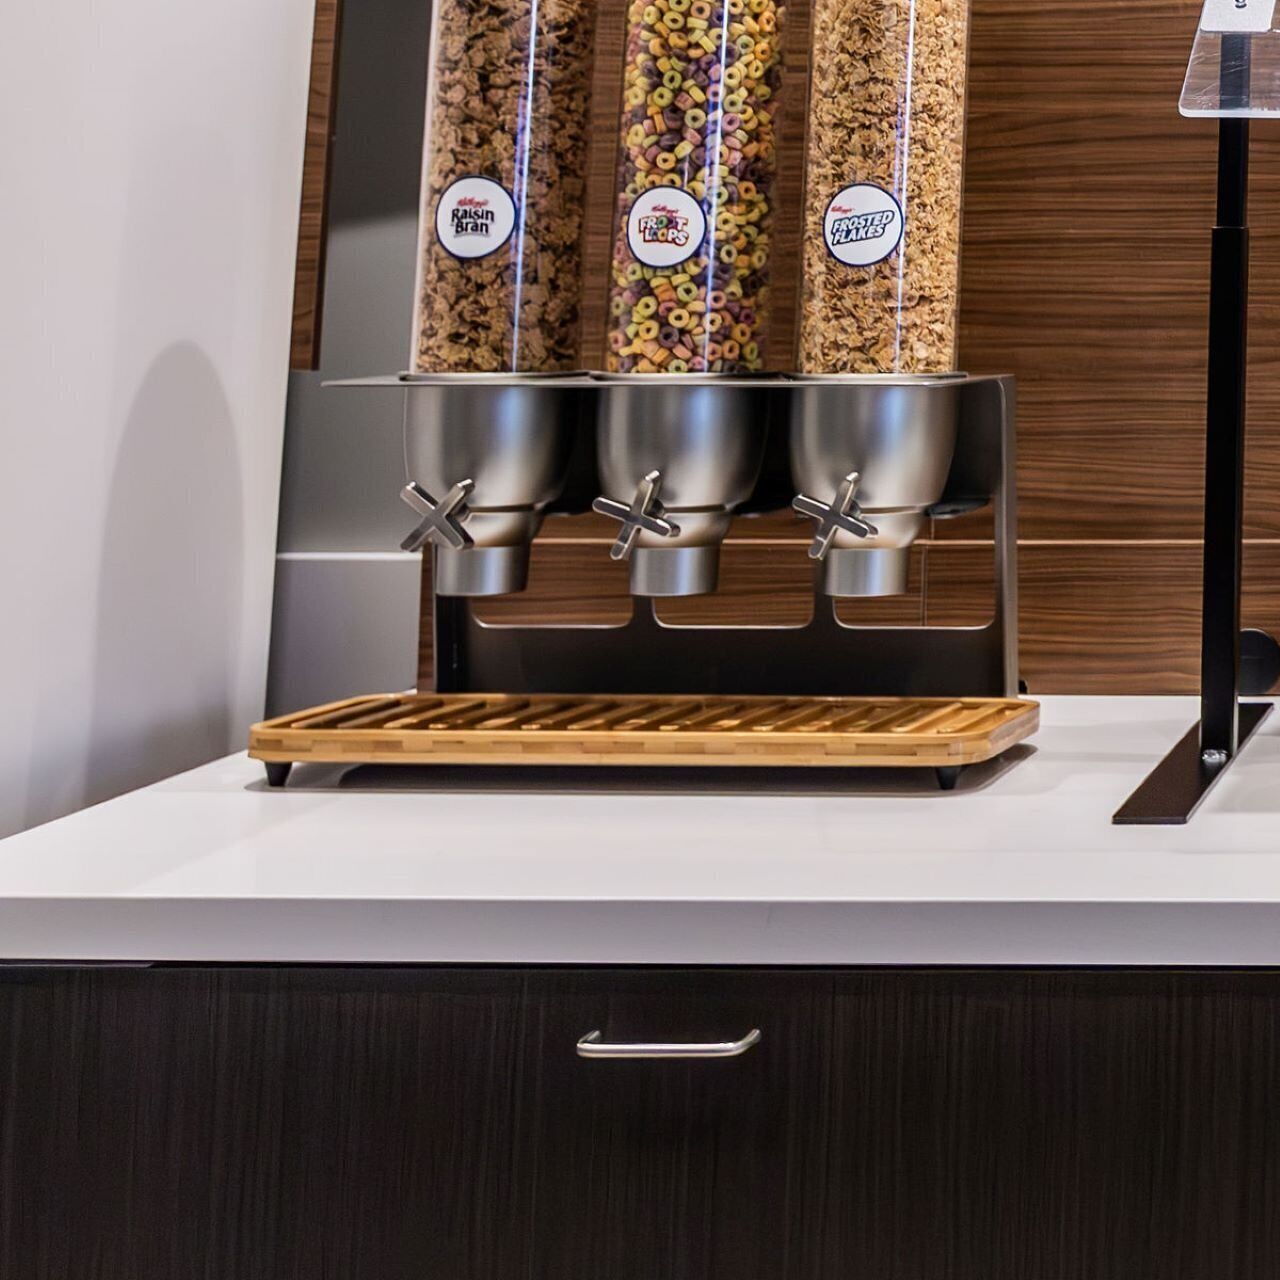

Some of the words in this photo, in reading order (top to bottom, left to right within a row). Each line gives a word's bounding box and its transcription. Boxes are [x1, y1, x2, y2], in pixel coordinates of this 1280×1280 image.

[451, 207, 495, 223] Raisin
[831, 209, 895, 234] FROSTED
[455, 221, 489, 234] Bran
[832, 223, 886, 246] FLAKES
[643, 228, 690, 247] LOOPS
